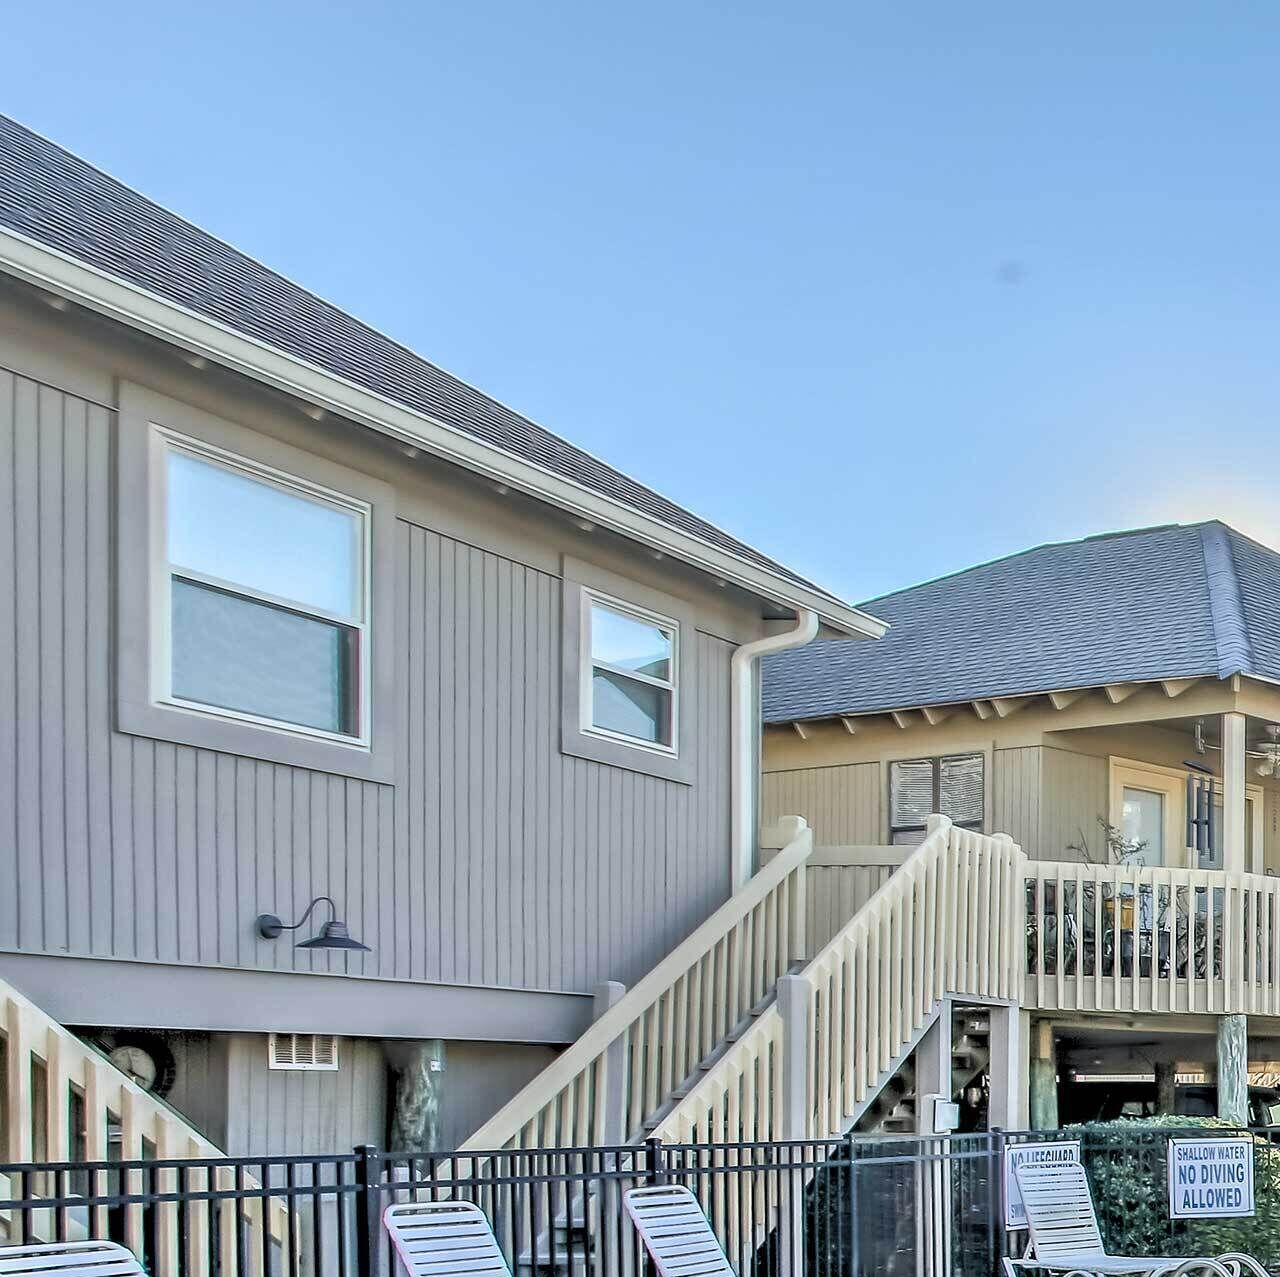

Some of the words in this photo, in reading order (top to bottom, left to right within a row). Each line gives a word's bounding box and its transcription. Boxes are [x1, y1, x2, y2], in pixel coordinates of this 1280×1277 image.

[1177, 1146, 1215, 1161] SHALLOW
[1217, 1145, 1246, 1160] WATER
[1178, 1165, 1196, 1185] NO
[1201, 1163, 1245, 1185] DIVING
[1182, 1187, 1242, 1209] ALLOWED
